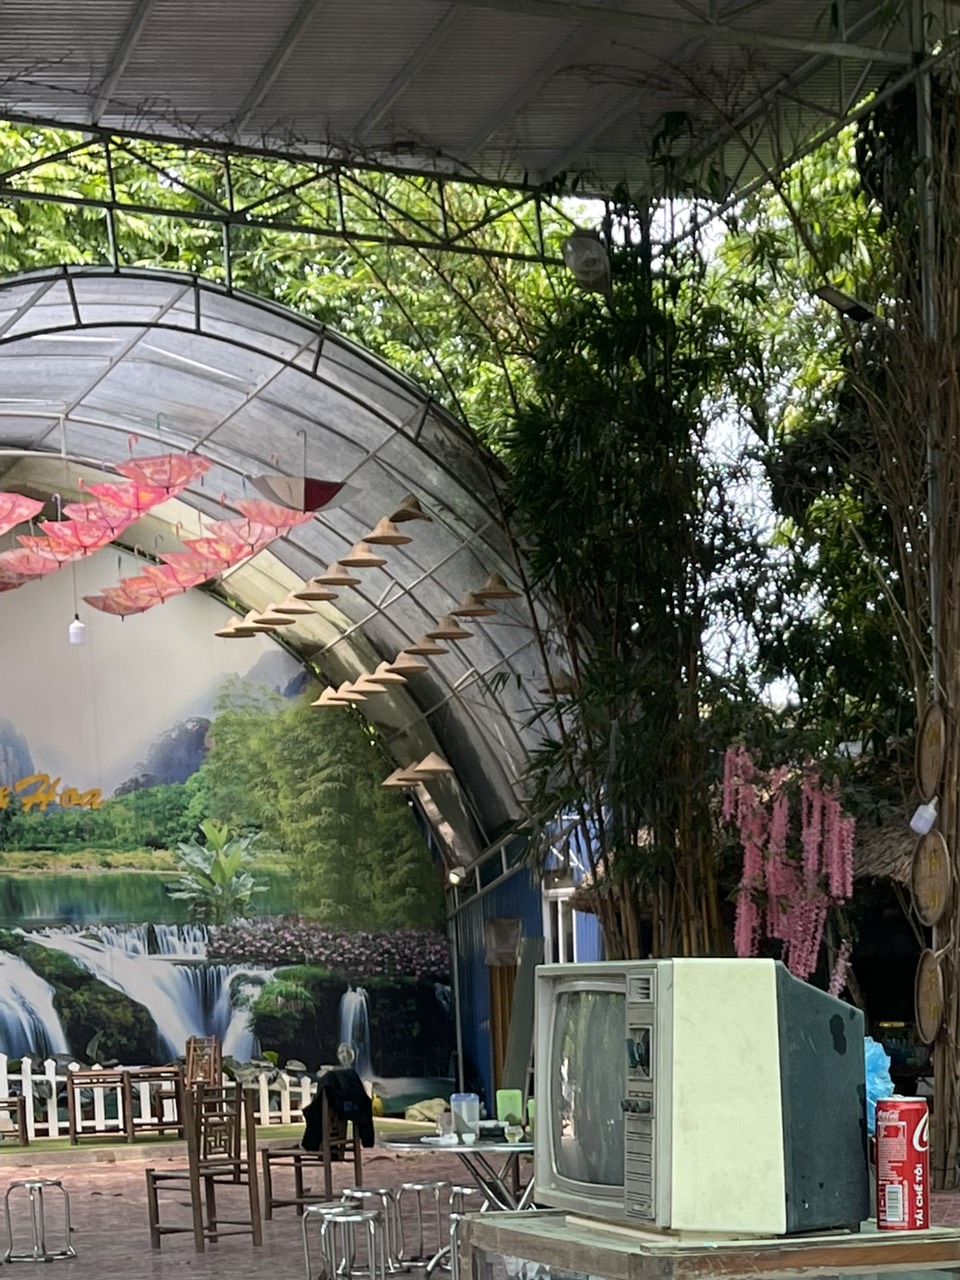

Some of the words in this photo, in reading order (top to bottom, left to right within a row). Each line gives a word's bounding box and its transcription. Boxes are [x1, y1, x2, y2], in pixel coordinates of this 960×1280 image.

[14, 773, 103, 813] Hoa
[913, 1163, 923, 1182] TÔI
[913, 1184, 923, 1207] CHẾ
[913, 1209, 923, 1227] TÁI
